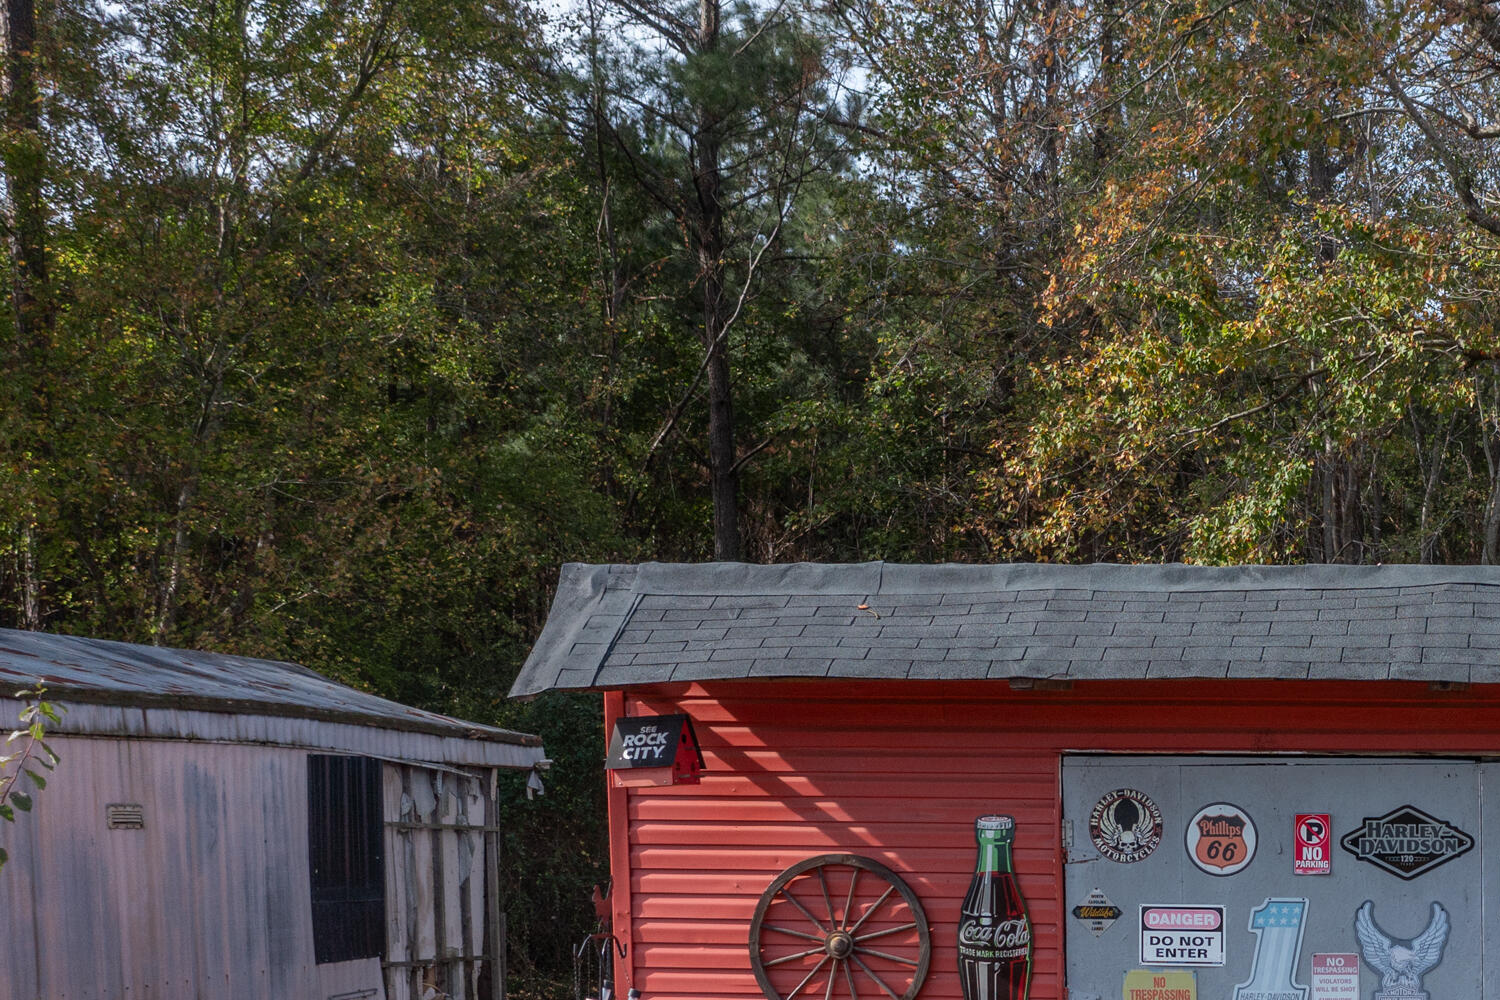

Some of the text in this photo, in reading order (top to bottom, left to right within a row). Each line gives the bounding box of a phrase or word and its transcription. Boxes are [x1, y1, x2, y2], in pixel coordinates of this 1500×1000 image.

[640, 726, 657, 734] SEE
[623, 732, 669, 747] ROCK
[1090, 789, 1163, 826] HARLEY-DAVIDSON
[1200, 820, 1241, 839] Phillips
[1366, 821, 1452, 838] HARLEY-
[1094, 836, 1160, 863] MOTORCYCLES
[1207, 840, 1238, 861] 66
[1302, 846, 1323, 860] NO
[1359, 838, 1458, 856] DAVIDSON
[1295, 860, 1329, 869] PARKING
[1149, 913, 1215, 926] DANGER
[1150, 936, 1215, 946] DO NOT
[975, 948, 994, 959] MARK
[1156, 949, 1208, 958] ENTER
[1326, 957, 1345, 966] NO
[1153, 977, 1166, 988] NO
[1129, 989, 1191, 1000] TRESPASSING
